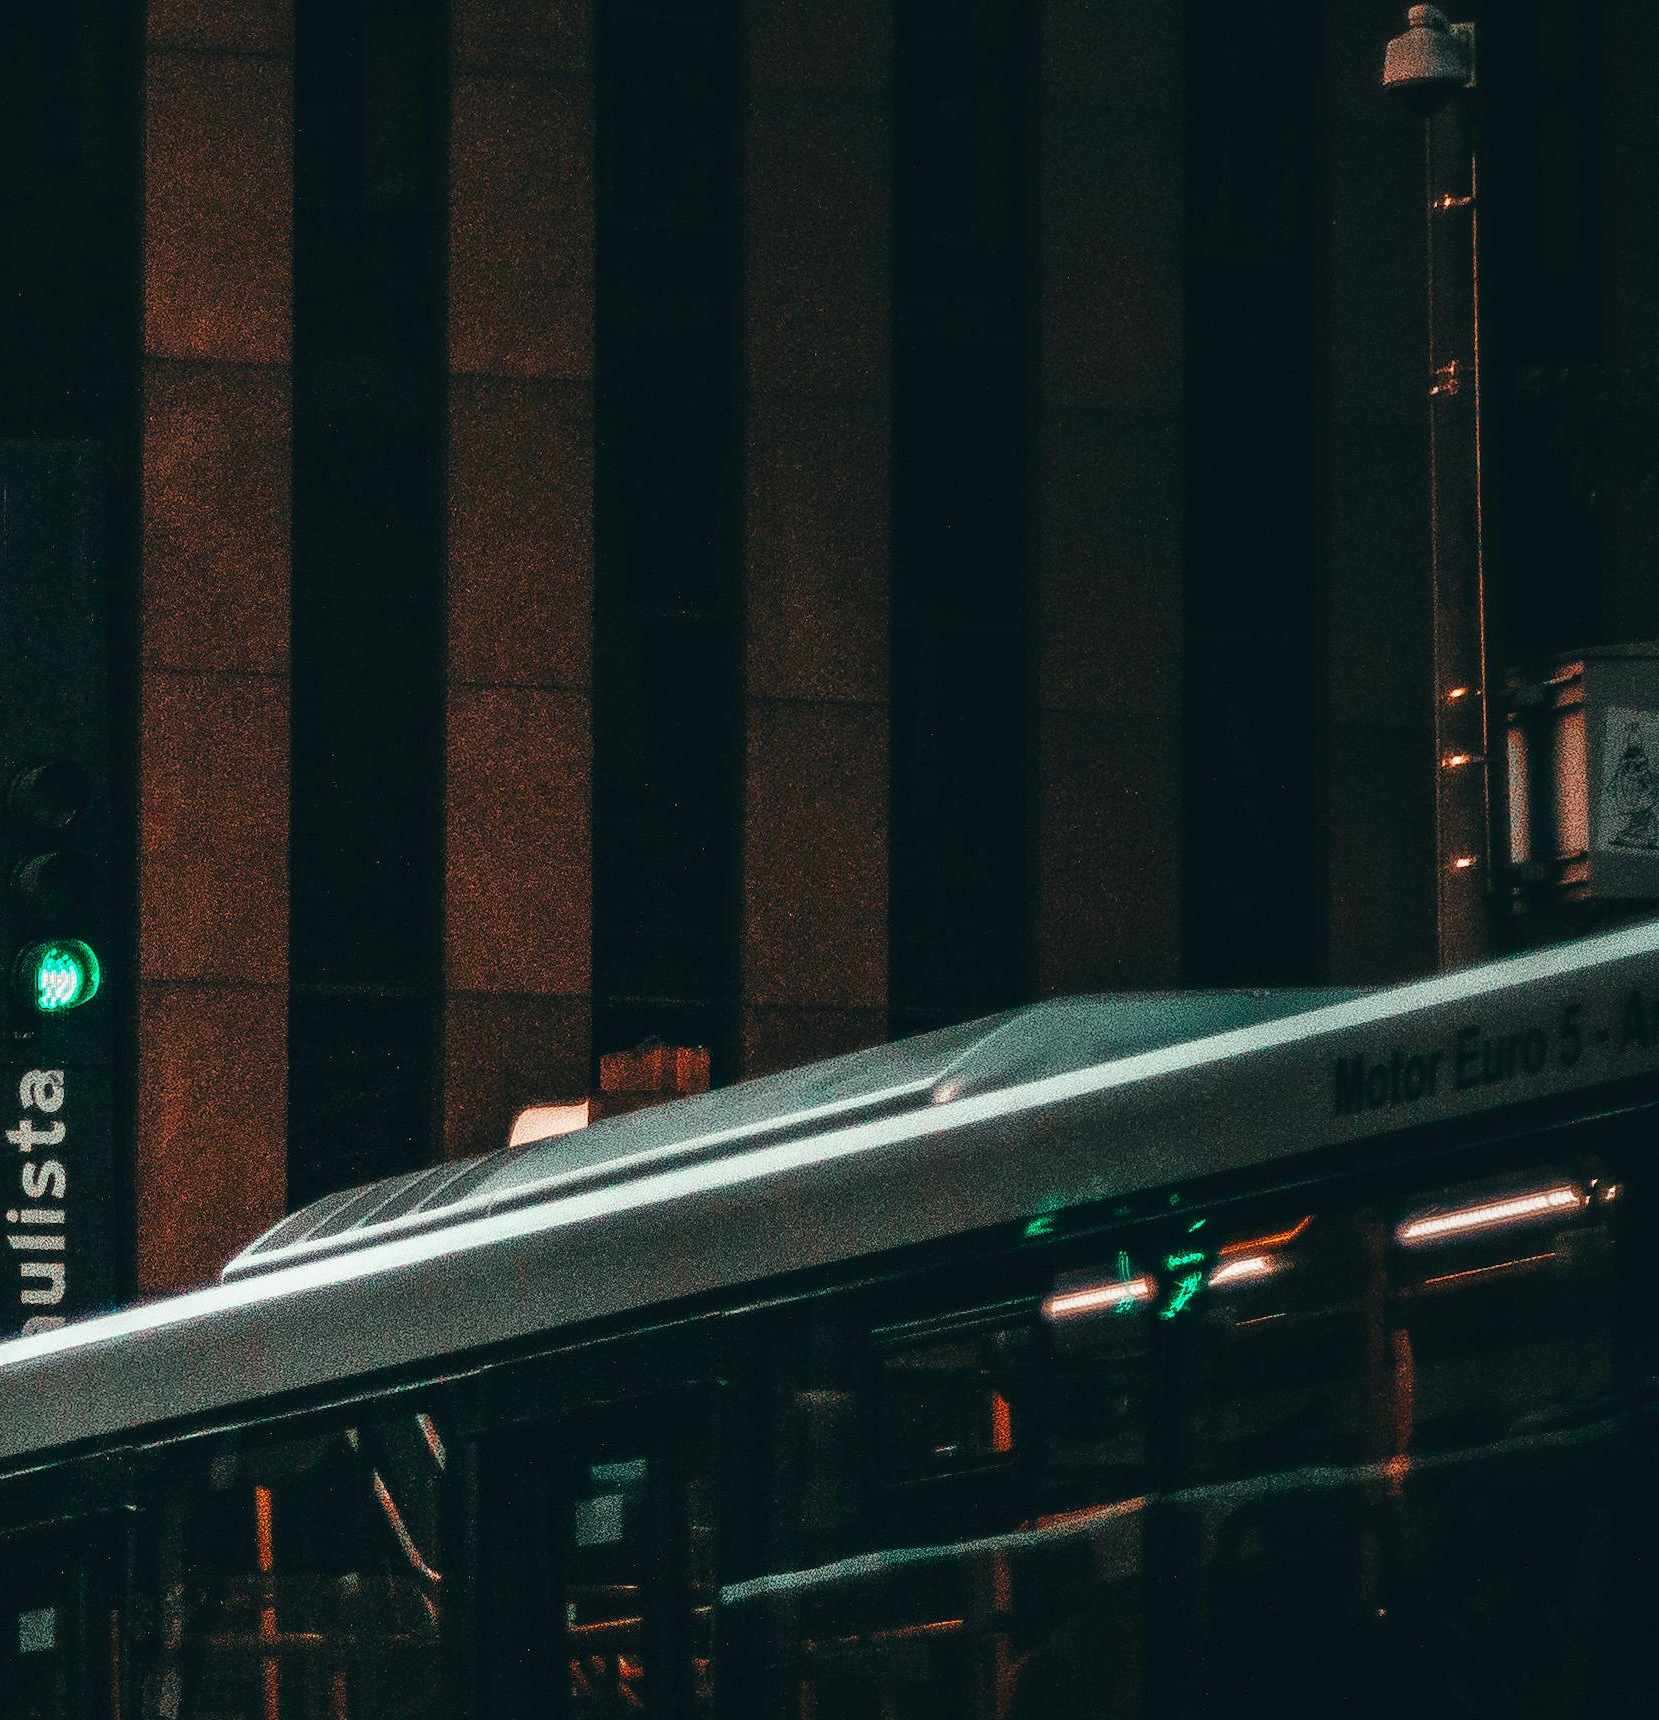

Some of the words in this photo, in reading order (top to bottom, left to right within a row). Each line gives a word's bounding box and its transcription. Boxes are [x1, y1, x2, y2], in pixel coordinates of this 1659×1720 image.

[1334, 1052, 1442, 1117] Motor
[1454, 1026, 1546, 1091] Euro
[1559, 1003, 1583, 1068] 5
